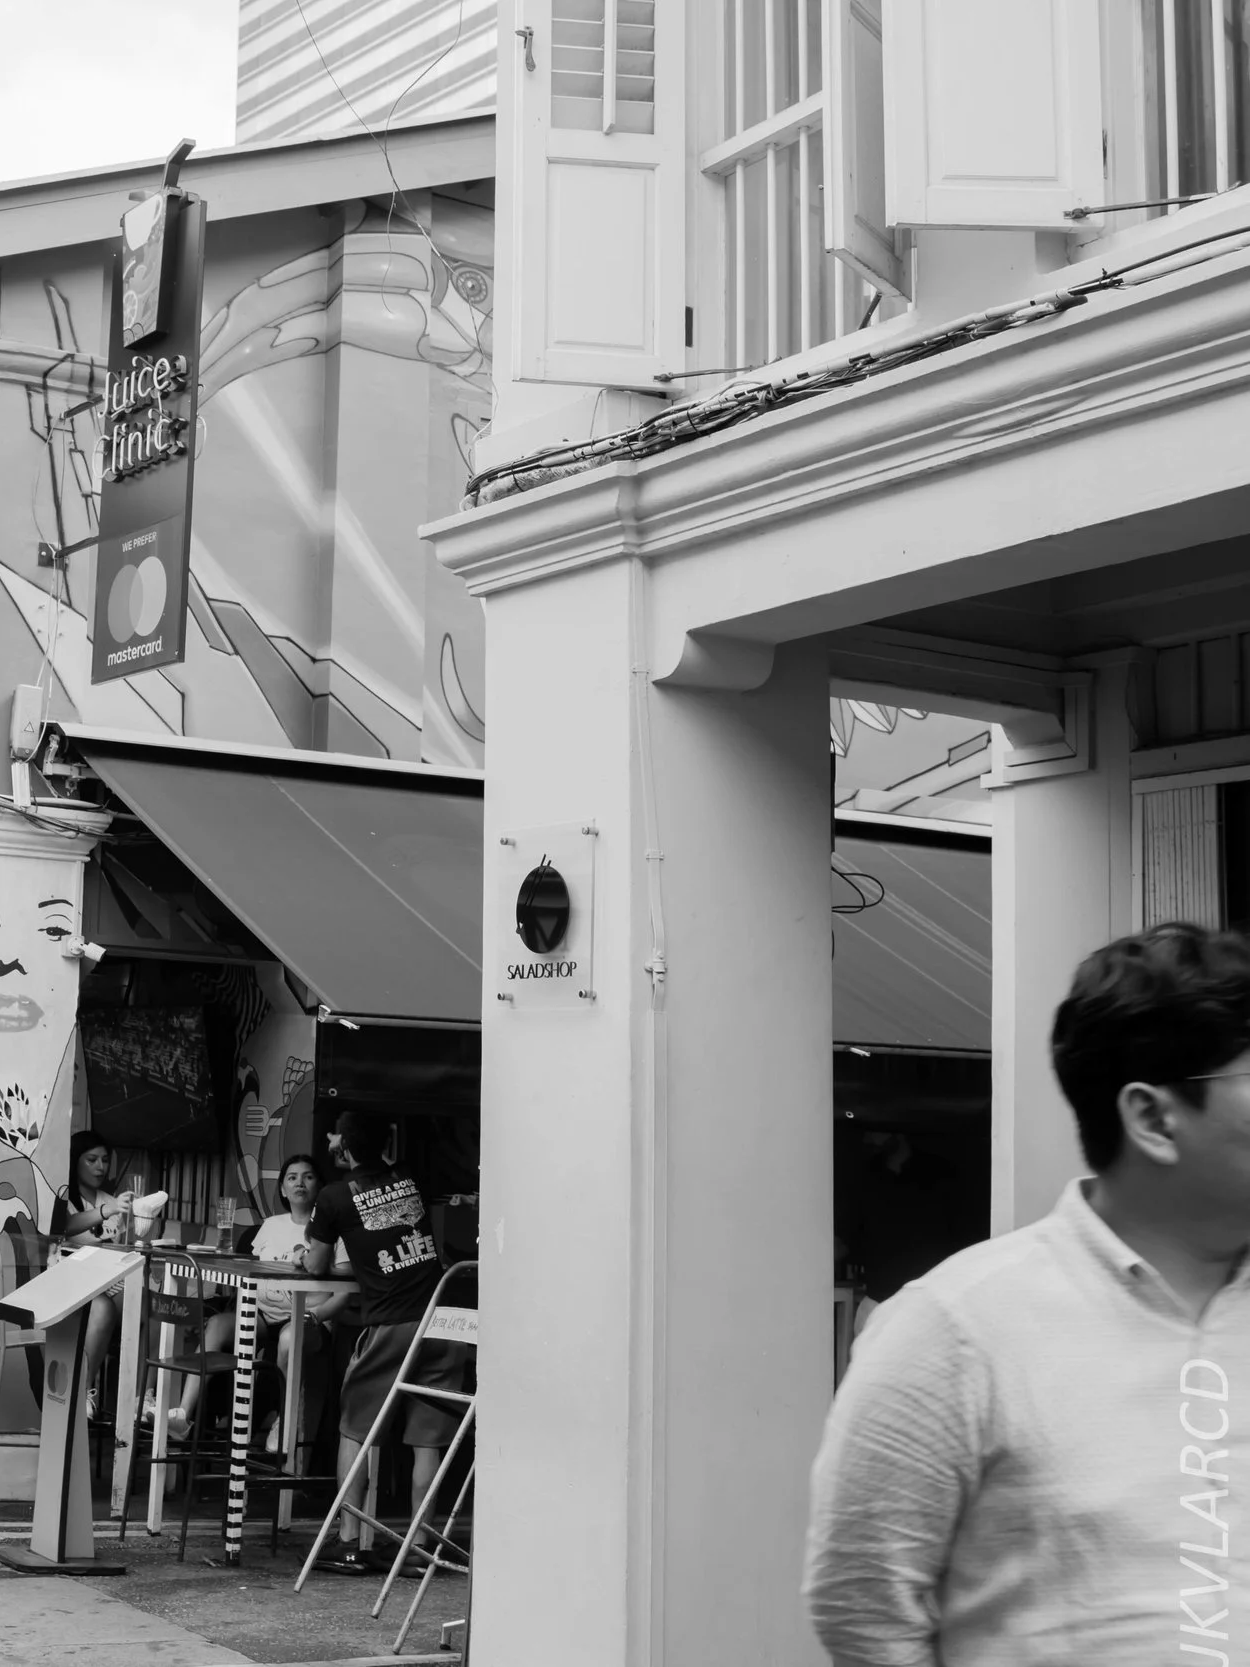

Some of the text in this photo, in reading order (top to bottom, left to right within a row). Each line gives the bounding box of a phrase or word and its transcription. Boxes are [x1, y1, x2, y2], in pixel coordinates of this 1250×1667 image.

[121, 531, 157, 553] WE PREFER
[107, 635, 163, 667] mastercard
[507, 961, 578, 980] SALADSHOP
[352, 1187, 383, 1203] GIVES
[385, 1185, 392, 1194] A
[393, 1178, 416, 1190] SOUL
[377, 1234, 435, 1268] & LIFE
[381, 1266, 394, 1274] TO
